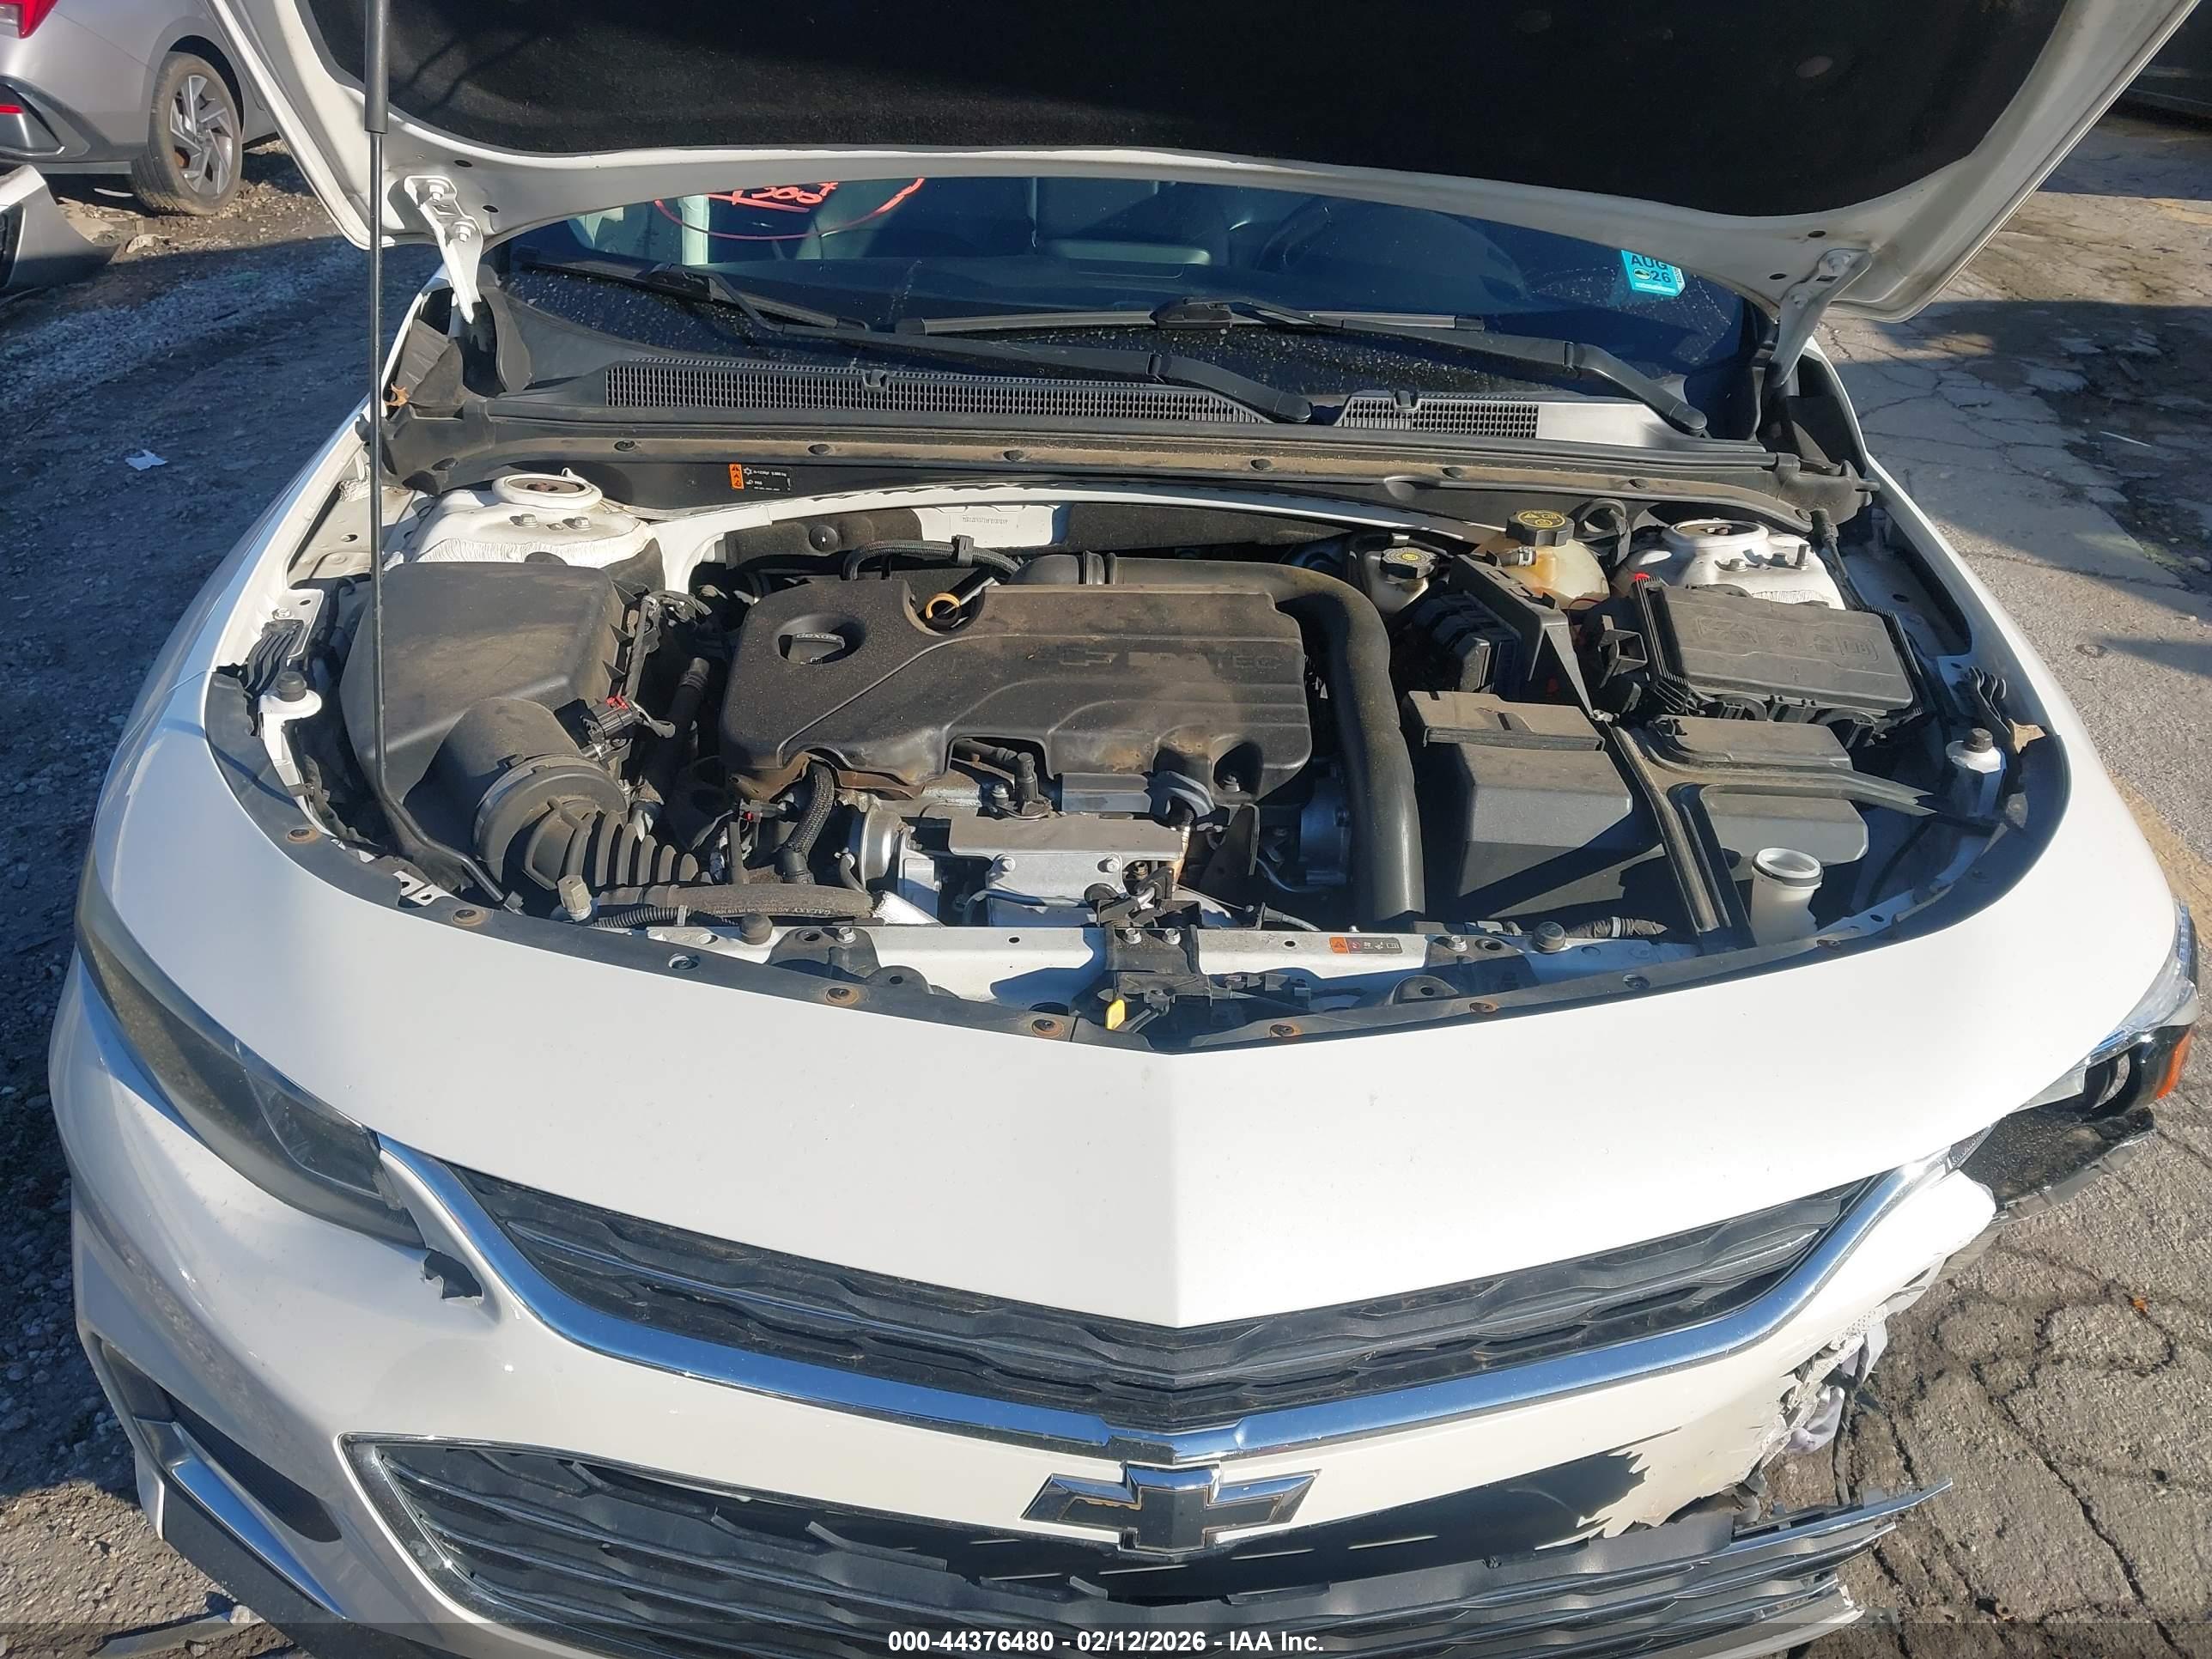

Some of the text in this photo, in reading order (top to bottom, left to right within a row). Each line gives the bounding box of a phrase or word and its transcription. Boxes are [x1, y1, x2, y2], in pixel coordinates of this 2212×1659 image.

[1631, 254, 1668, 270] AUG
[1650, 270, 1671, 283] 26
[796, 632, 837, 641] dexos
